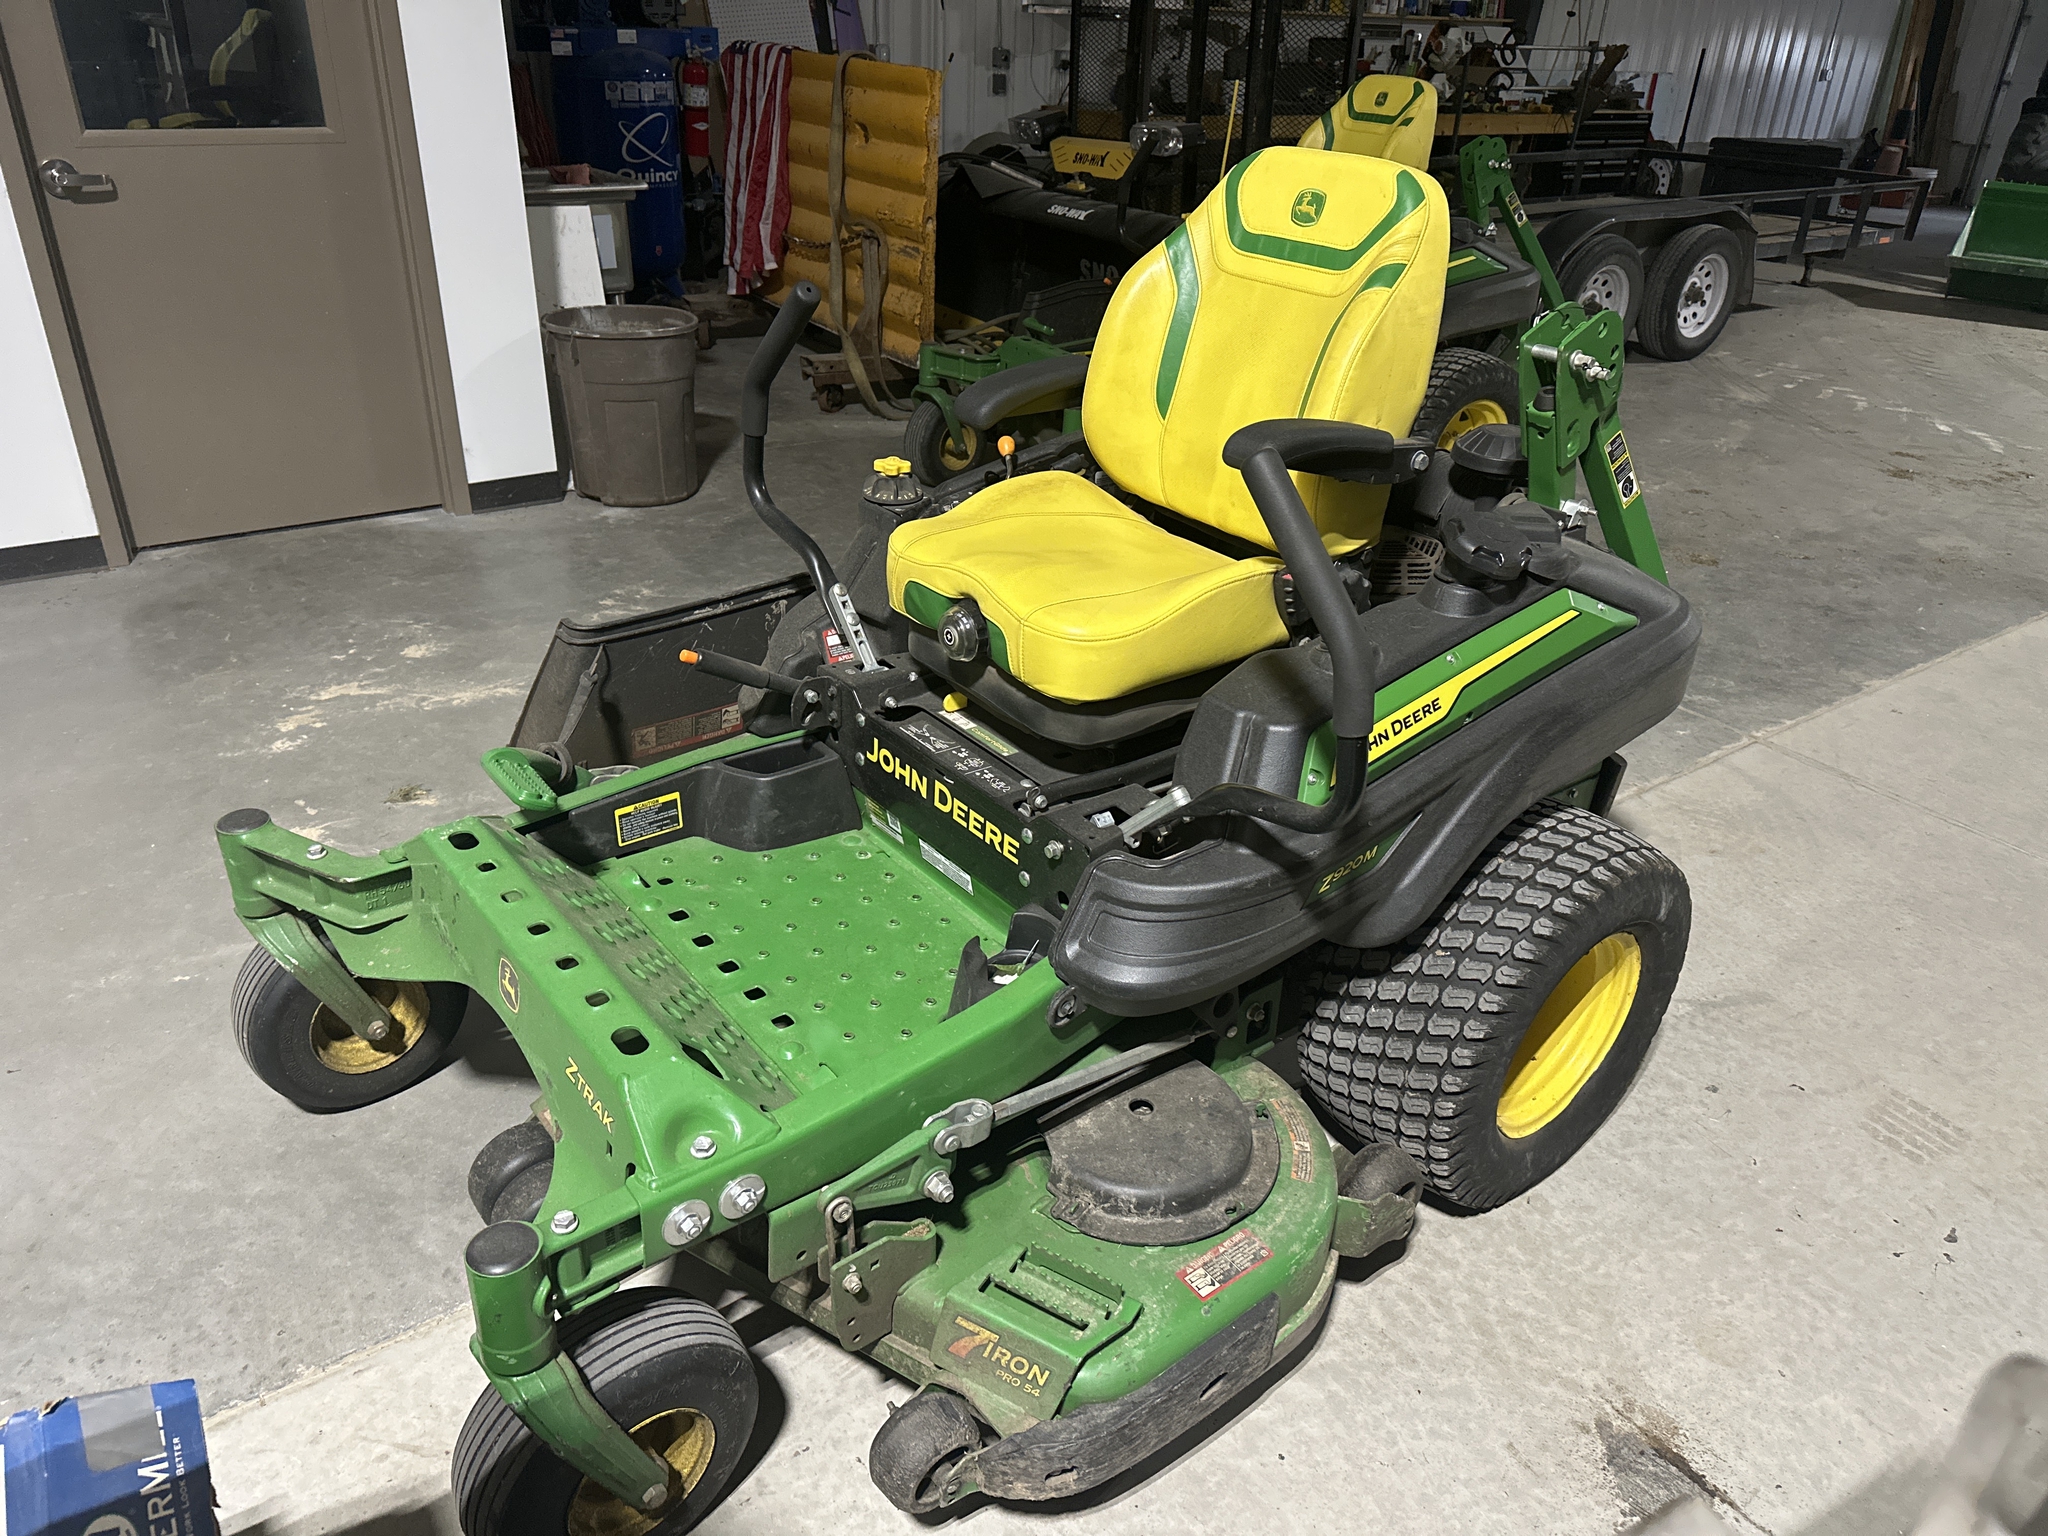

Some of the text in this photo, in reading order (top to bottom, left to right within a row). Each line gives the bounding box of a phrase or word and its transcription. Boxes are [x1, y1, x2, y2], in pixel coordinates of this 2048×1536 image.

[1073, 151, 1110, 167] SNO-WAY
[1047, 204, 1095, 220] SNO-WAY
[1368, 697, 1442, 752] HN DEERE
[638, 799, 660, 809] CAUTION
[866, 737, 928, 799] JOHN
[933, 779, 1020, 866] DEERE
[1317, 844, 1379, 894] Z920M
[564, 1055, 615, 1134] ZTRAK
[947, 1315, 1051, 1387] 7 IRON
[995, 1369, 1041, 1397] PRO 54
[172, 1436, 185, 1477] BETTER
[178, 1479, 190, 1510] LOOK
